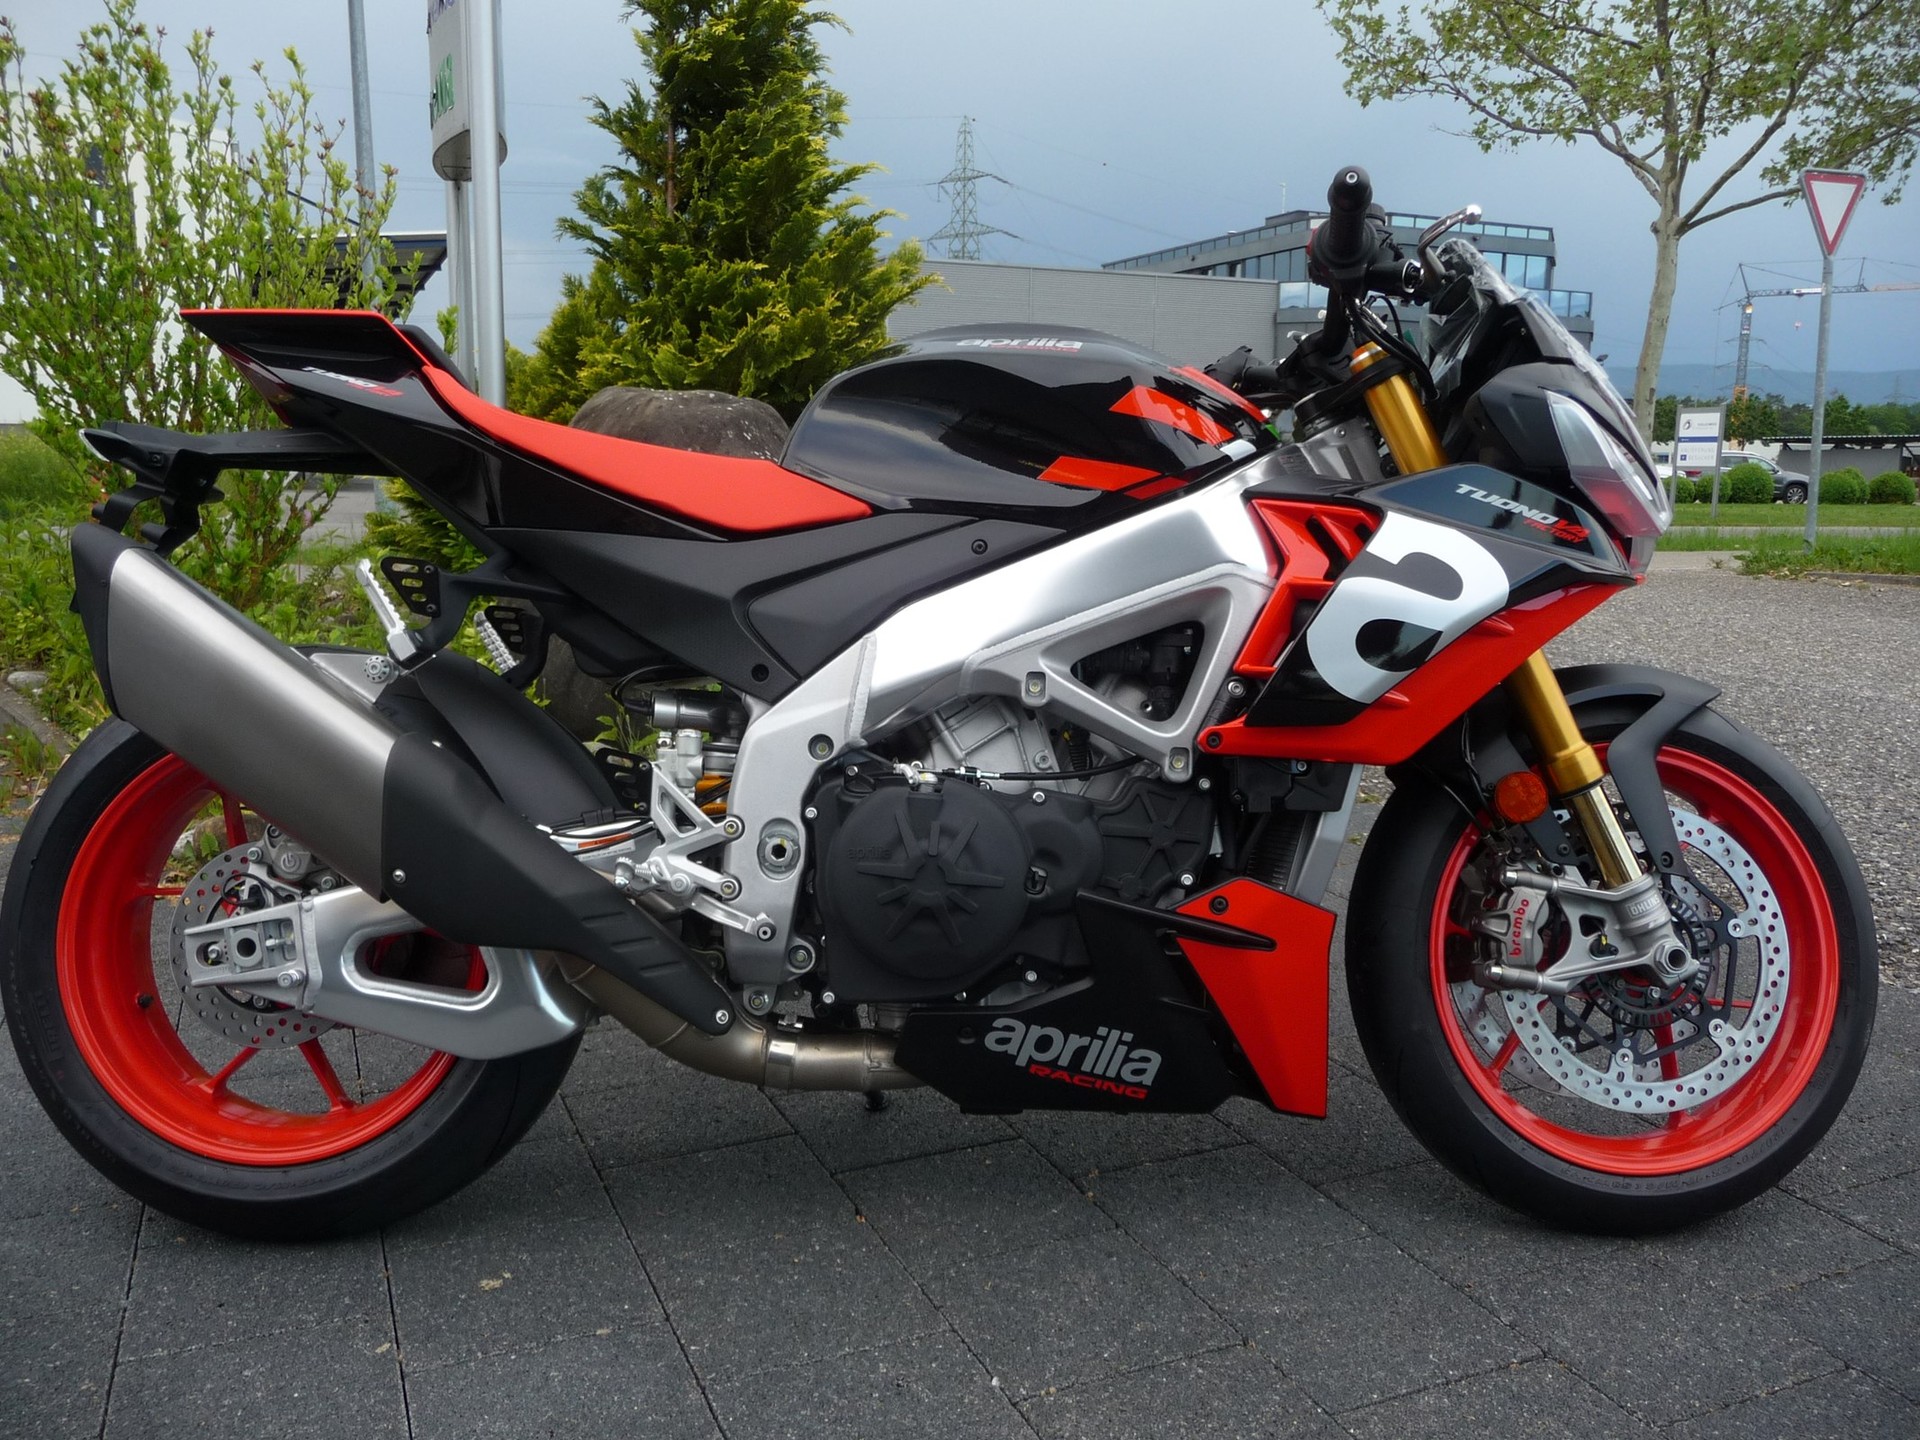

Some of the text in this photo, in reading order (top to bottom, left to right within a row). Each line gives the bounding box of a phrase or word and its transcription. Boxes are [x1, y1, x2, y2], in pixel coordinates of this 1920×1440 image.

[956, 337, 1083, 349] aprilia
[1455, 483, 1559, 524] TUONO
[1508, 898, 1530, 957] brembo
[984, 1017, 1162, 1086] aprilia
[1028, 1063, 1148, 1099] RACING
